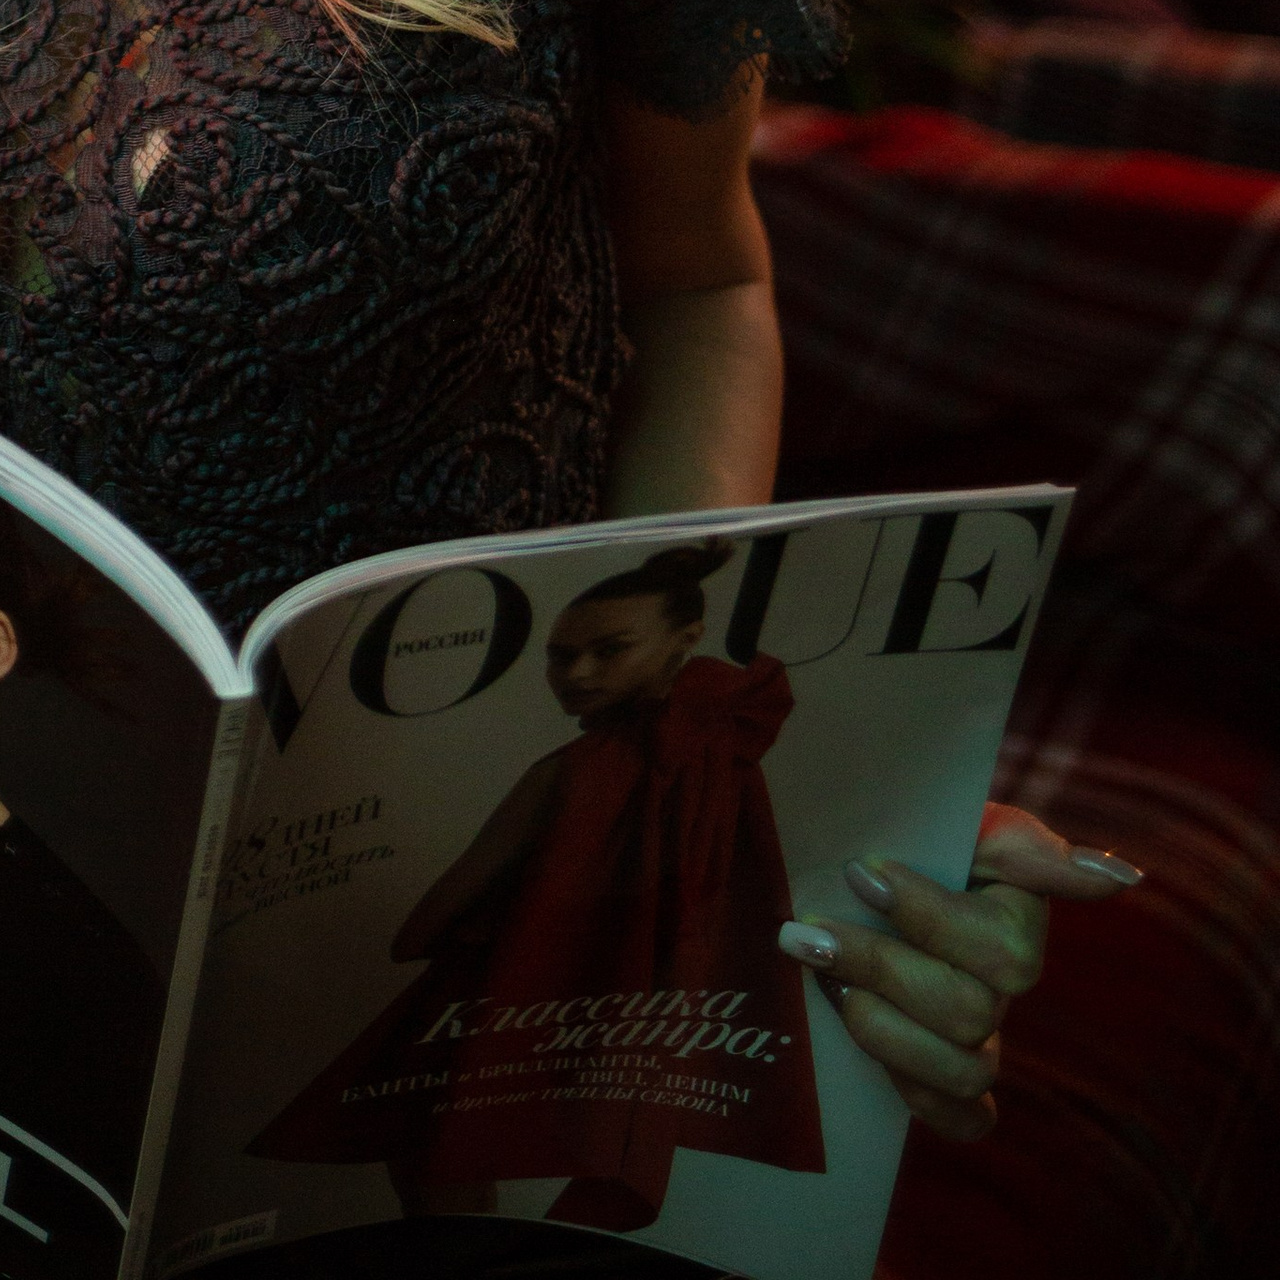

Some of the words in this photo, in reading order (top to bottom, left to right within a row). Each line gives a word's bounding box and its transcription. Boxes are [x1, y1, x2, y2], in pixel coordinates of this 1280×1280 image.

[255, 504, 1055, 755] VOUE
[394, 628, 486, 658] РОССИЯ
[415, 990, 748, 1045] Классика
[533, 1020, 791, 1063] жанра:
[340, 1070, 451, 1103] БАНТЫ
